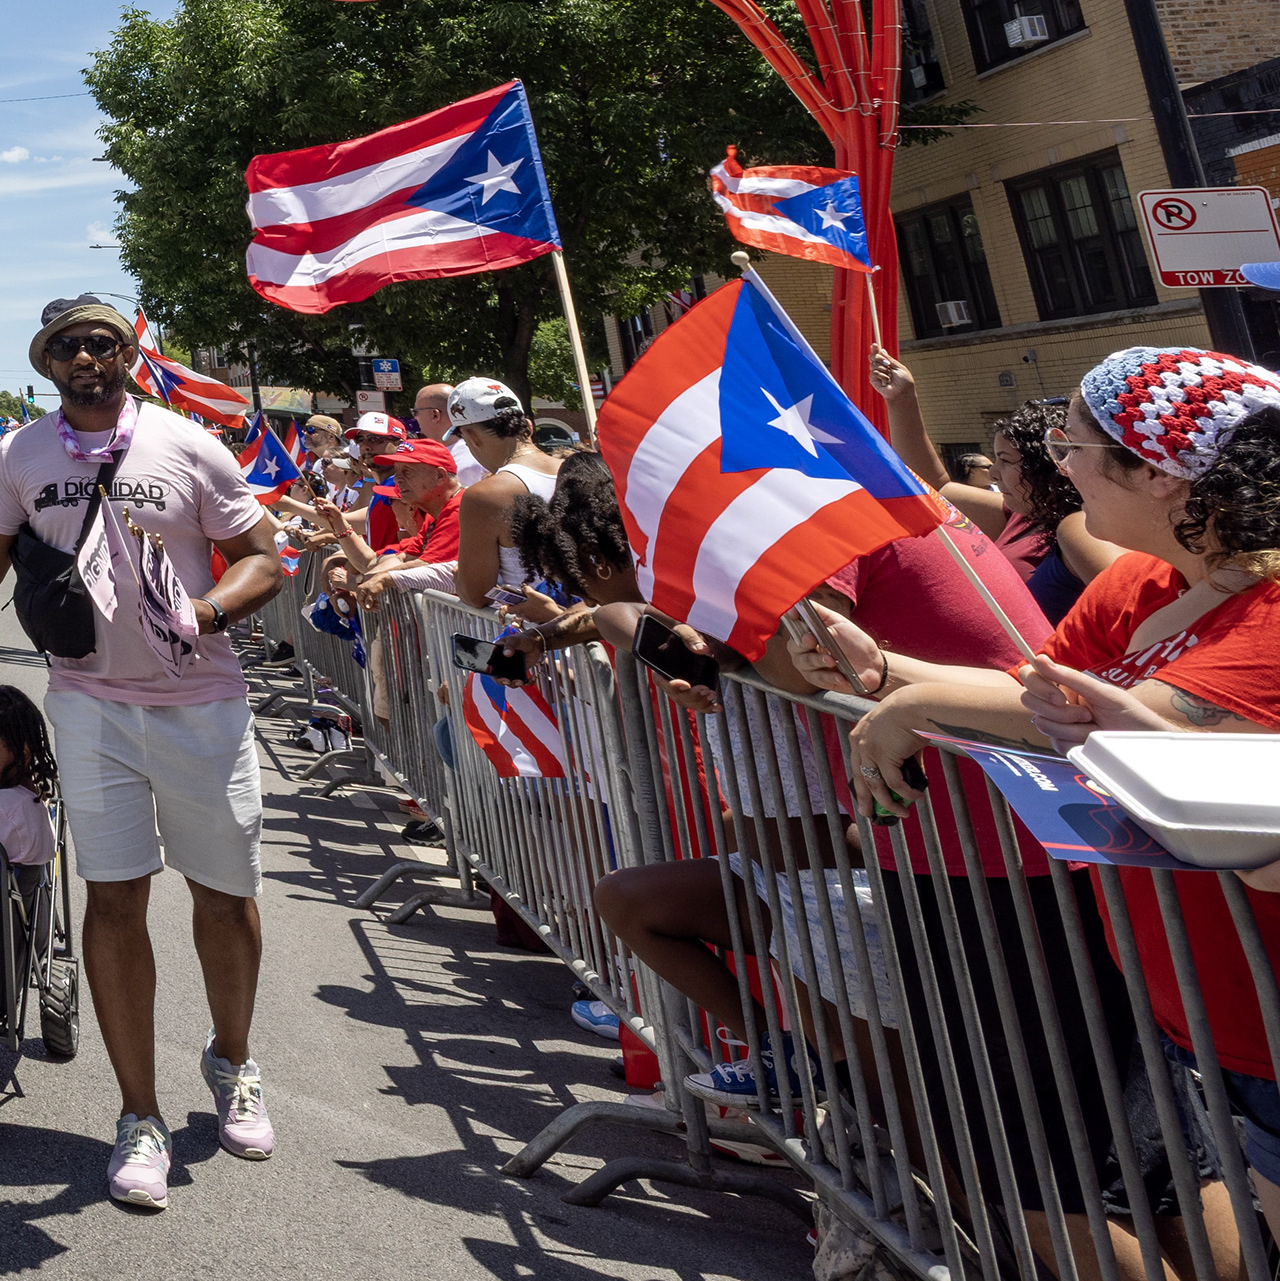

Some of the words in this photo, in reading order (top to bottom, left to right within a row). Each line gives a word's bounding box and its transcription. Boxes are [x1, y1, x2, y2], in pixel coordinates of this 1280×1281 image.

[1175, 272, 1214, 285] TOW
[1224, 271, 1248, 284] ZO
[65, 482, 164, 499] DIGIDAD
[84, 542, 110, 589] DIGNID
